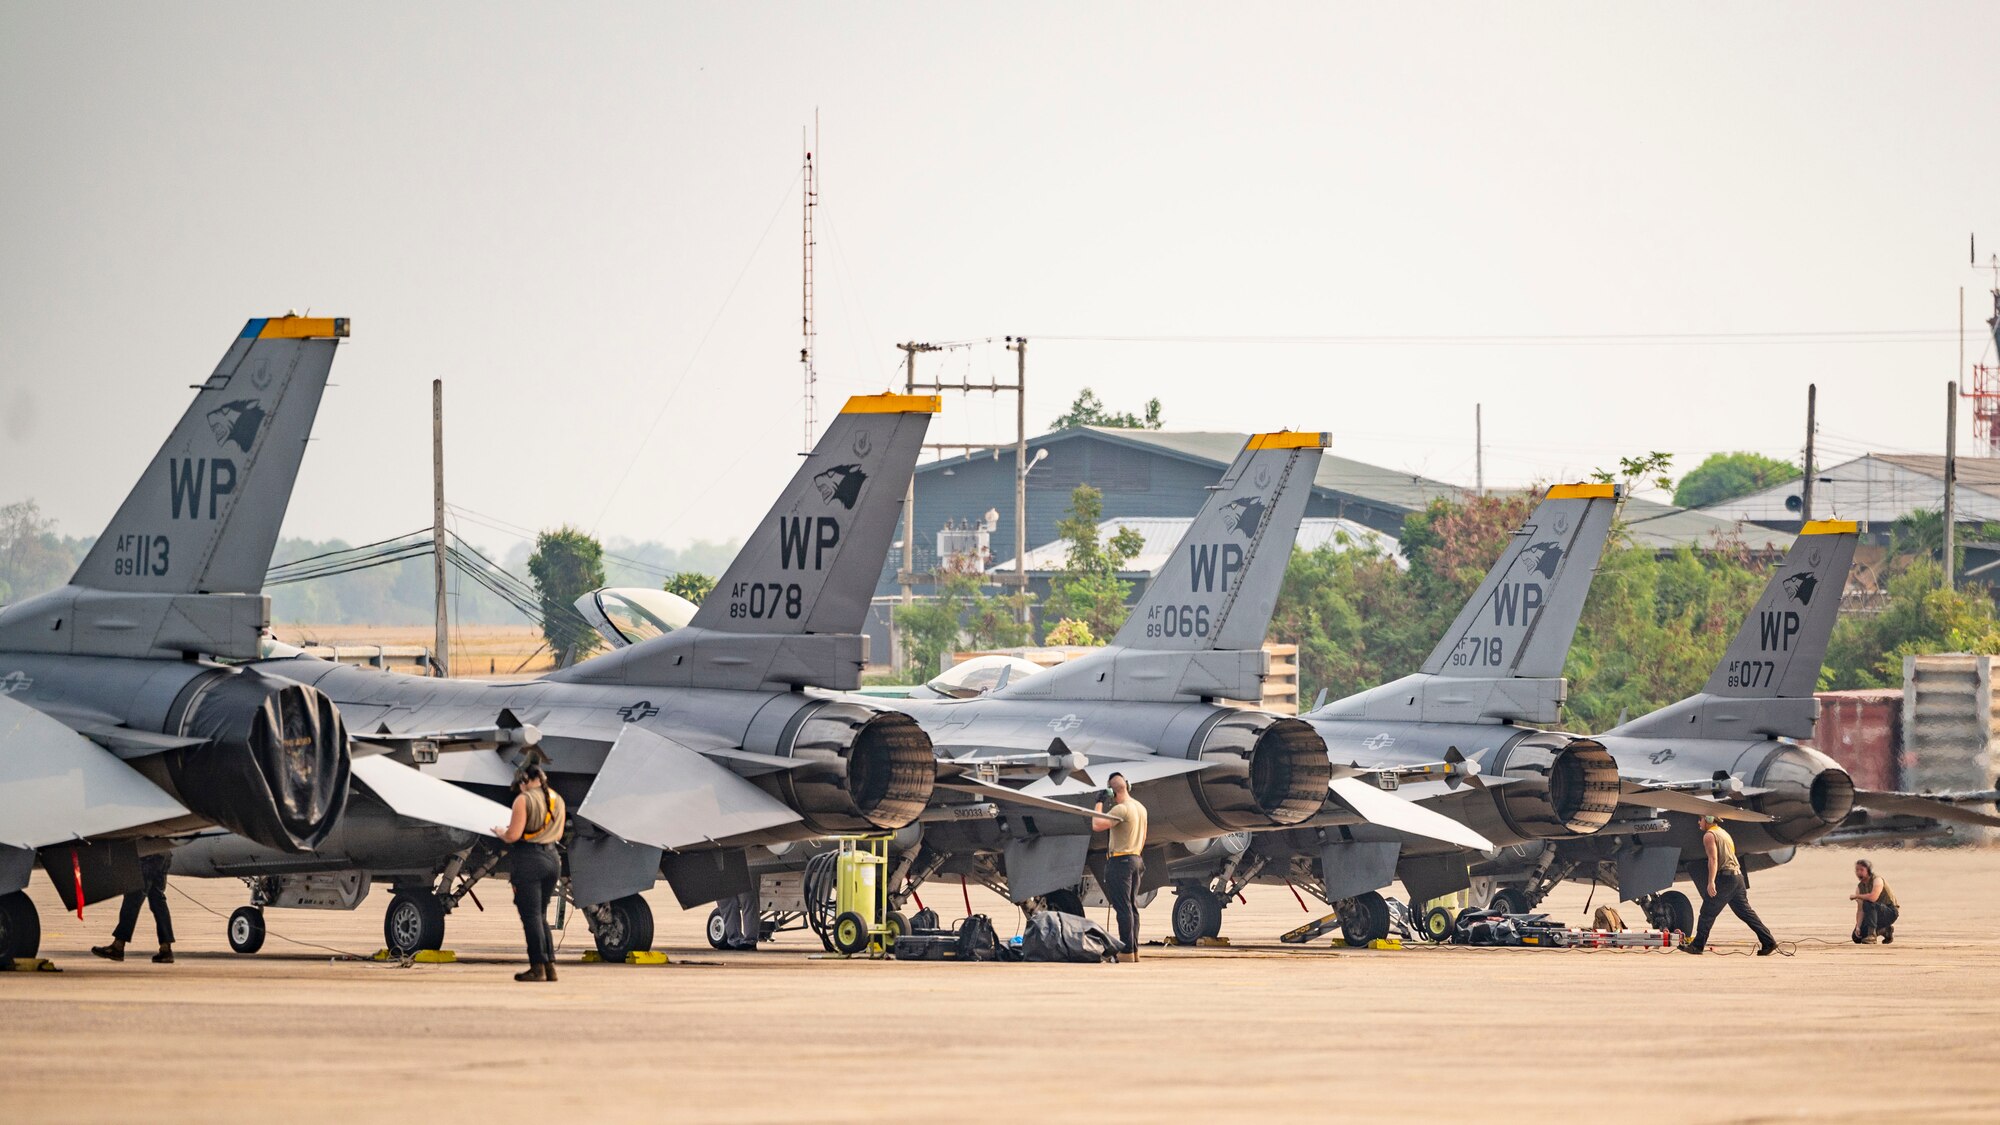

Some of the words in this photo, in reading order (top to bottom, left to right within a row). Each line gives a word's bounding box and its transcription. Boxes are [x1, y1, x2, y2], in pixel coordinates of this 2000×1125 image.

[170, 458, 237, 520] WP
[116, 535, 135, 552] AF
[135, 535, 170, 576] 113
[780, 516, 840, 571] WP
[114, 558, 133, 576] 89
[1190, 543, 1244, 593] WP
[731, 583, 749, 598] AF
[749, 583, 802, 619] 078
[730, 603, 747, 618] 89
[1147, 605, 1163, 619] AF
[1494, 583, 1543, 627] WP
[1146, 624, 1161, 638] 89
[1163, 605, 1210, 638] 066
[1760, 611, 1800, 651] WP
[1452, 653, 1467, 666] 90
[1468, 637, 1503, 666] 718
[1728, 661, 1740, 672] AF
[1740, 661, 1775, 688] 077
[1727, 676, 1739, 687] 89
